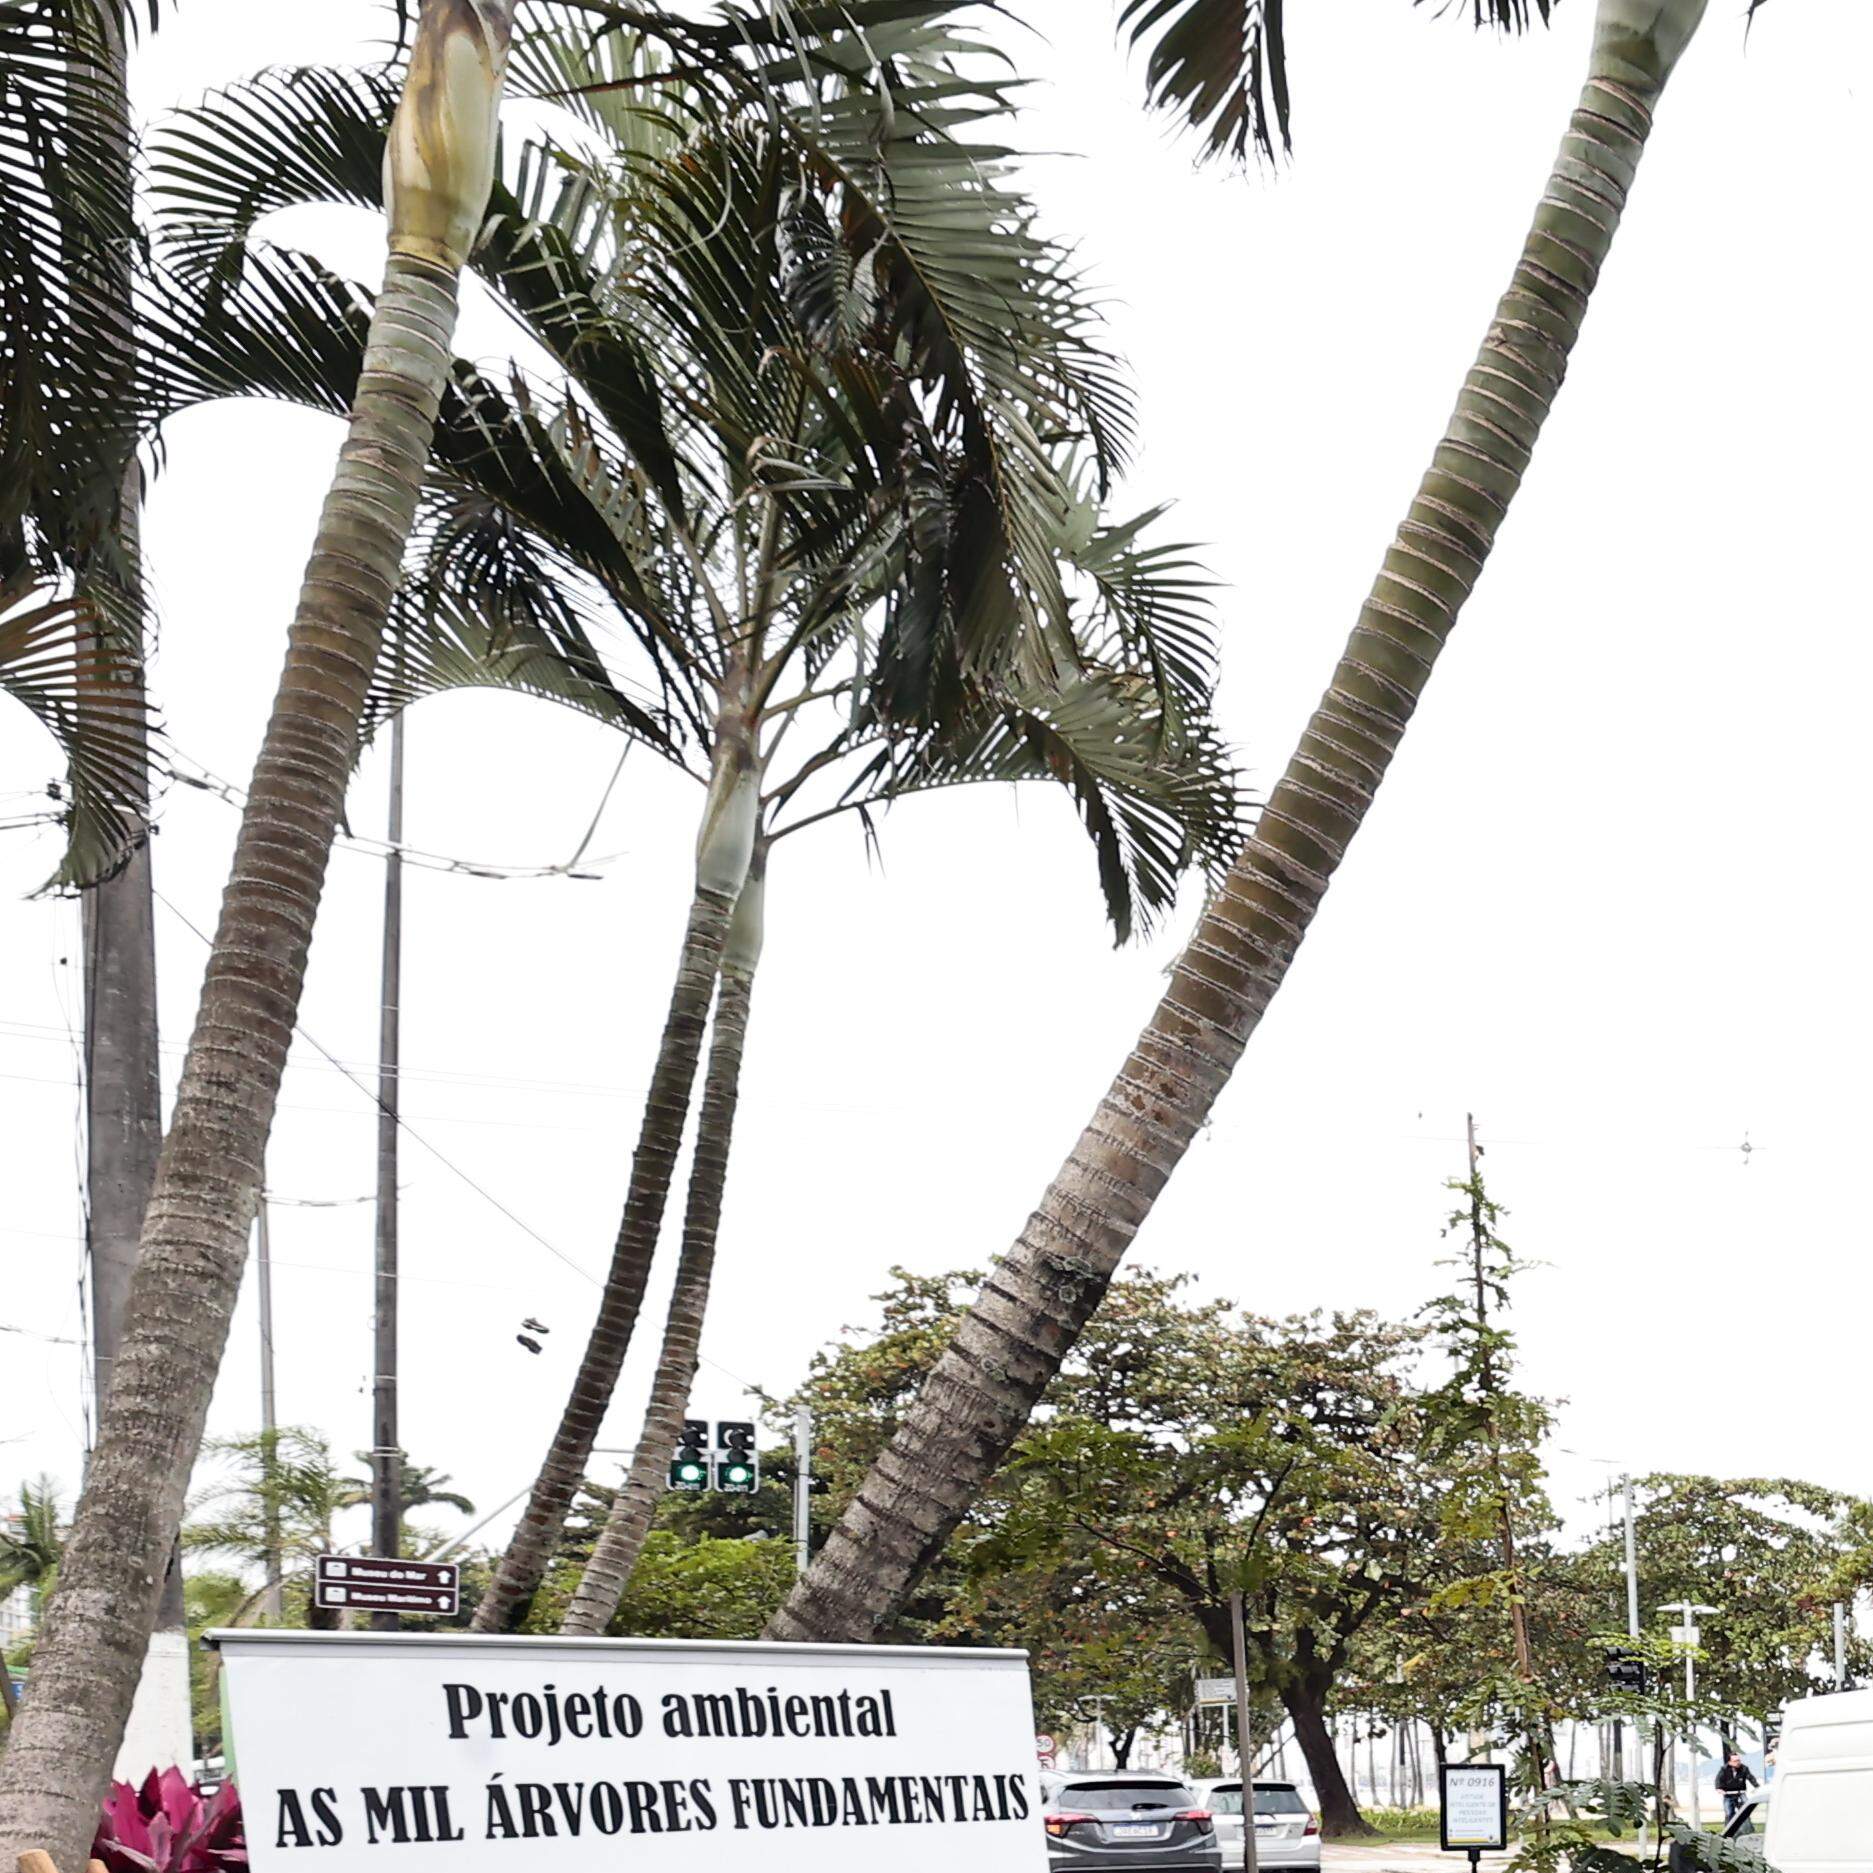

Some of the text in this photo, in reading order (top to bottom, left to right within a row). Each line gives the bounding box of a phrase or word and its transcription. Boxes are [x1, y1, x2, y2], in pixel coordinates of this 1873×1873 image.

[443, 1684, 896, 1745] Projeto ambiental
[1036, 1738, 1051, 1748] 50
[1467, 1777, 1494, 1787] 0916
[276, 1773, 1028, 1847] AS MIL ÁRVORES FUNDAMENTAIS
